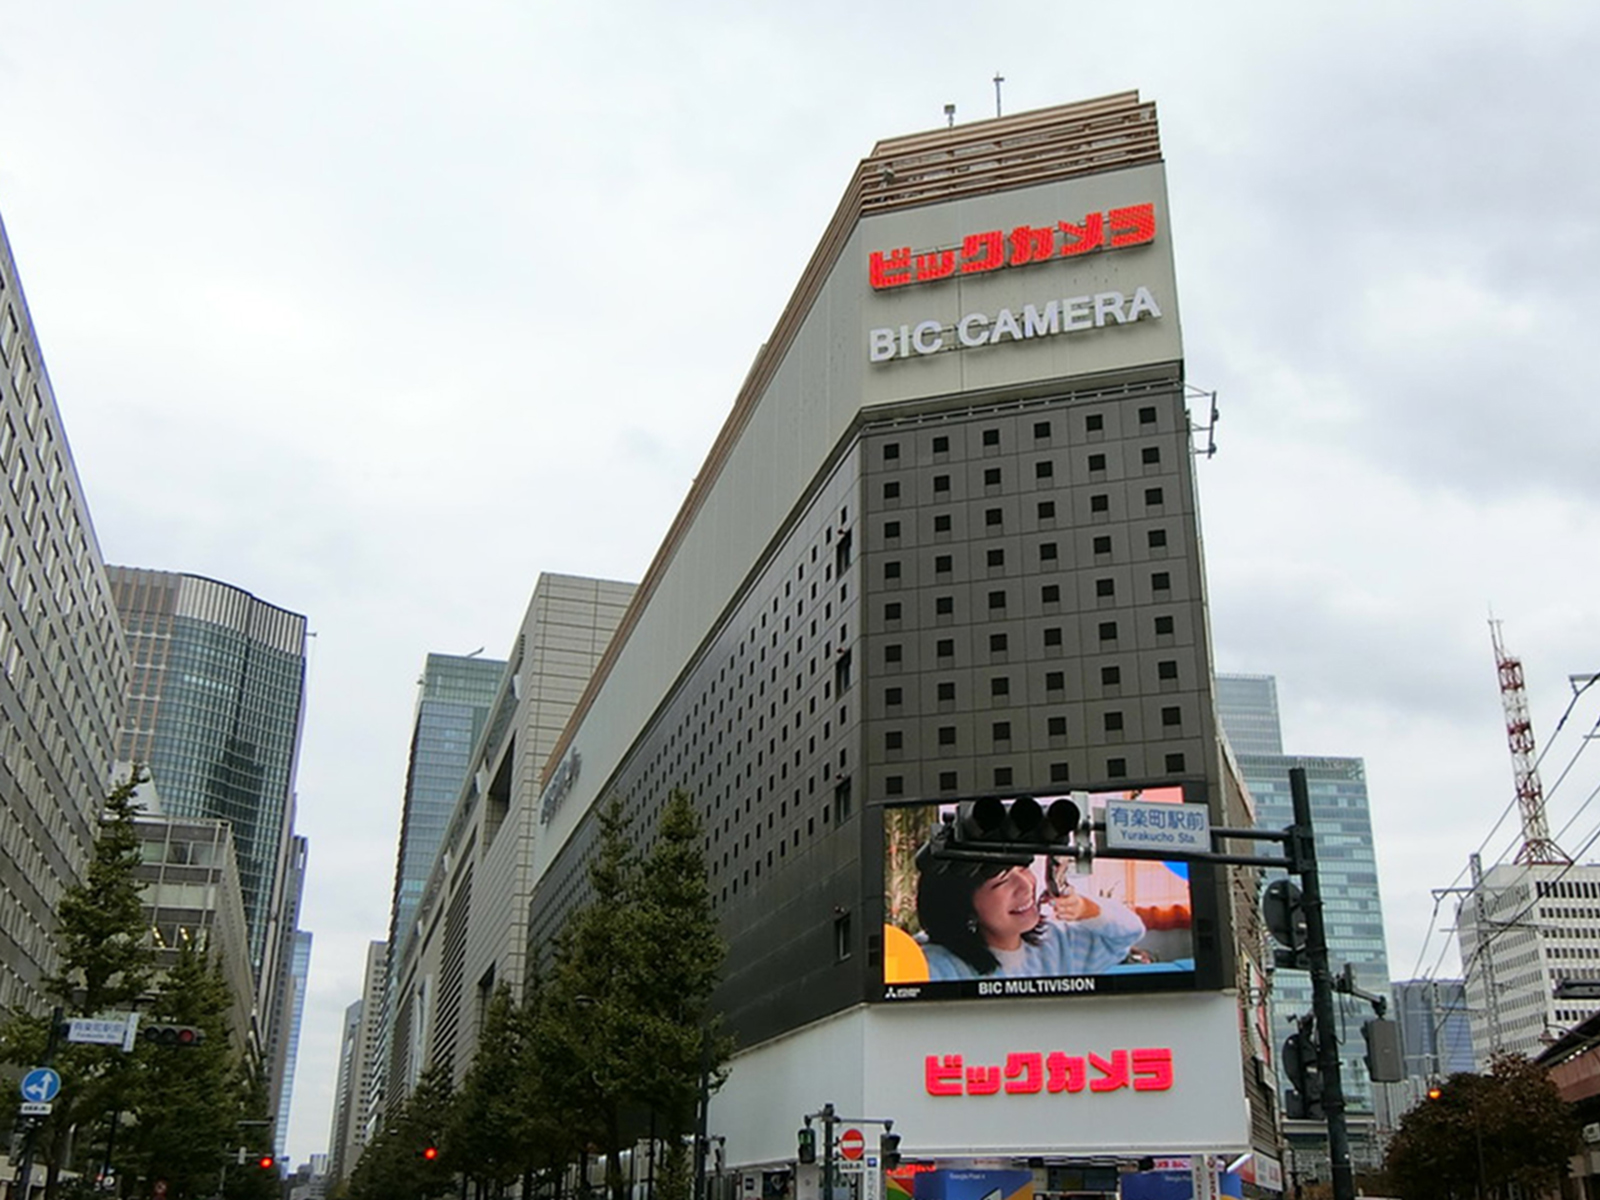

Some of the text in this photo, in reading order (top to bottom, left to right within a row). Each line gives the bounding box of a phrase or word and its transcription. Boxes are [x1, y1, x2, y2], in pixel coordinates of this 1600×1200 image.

[869, 203, 1156, 290] ビックカメラ
[869, 286, 1162, 362] BIC CAMERA
[1111, 807, 1204, 831] 有楽町駅前
[1121, 830, 1196, 844] Yurakucho Sta.
[978, 978, 1095, 995] BIC MULTIVISION
[925, 1048, 1174, 1096] ビックカメラ
